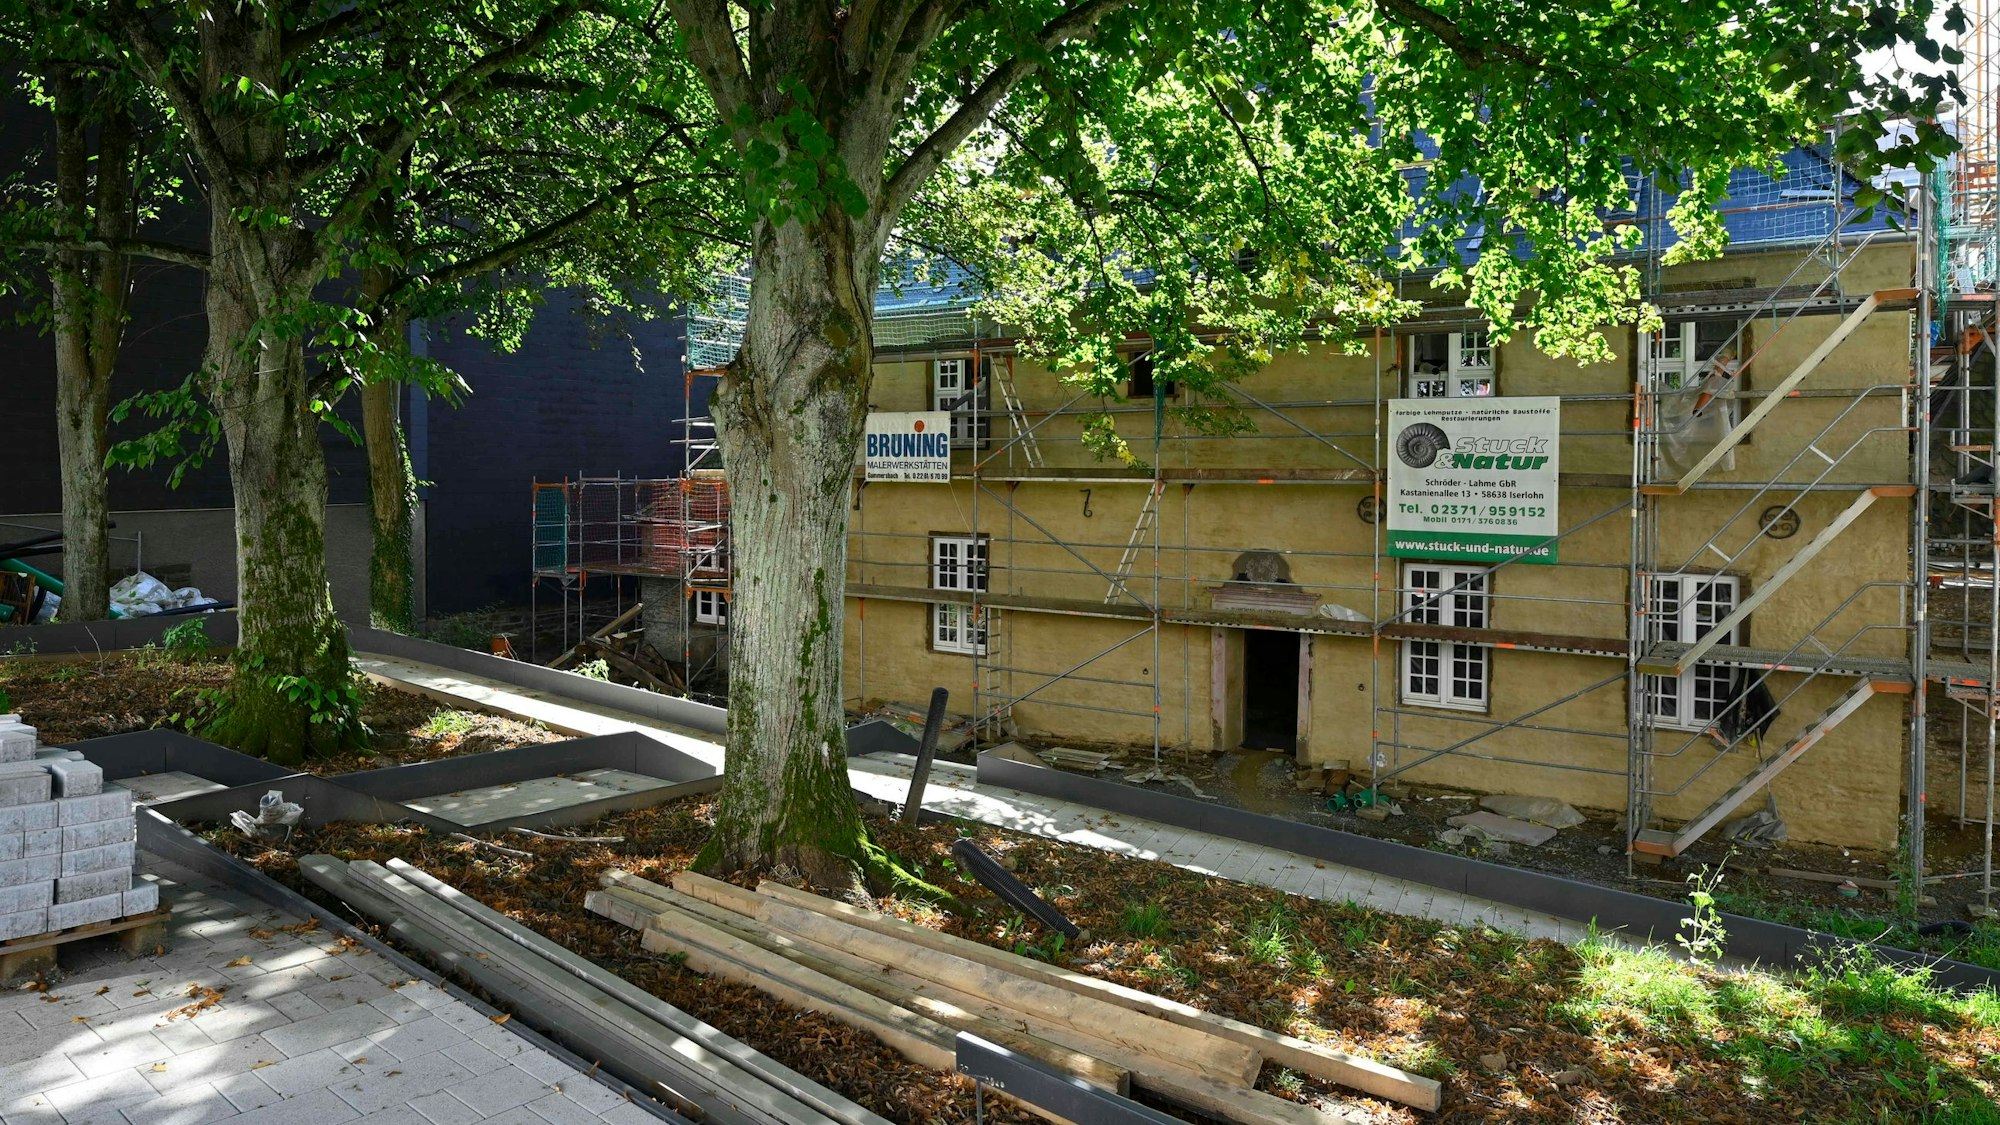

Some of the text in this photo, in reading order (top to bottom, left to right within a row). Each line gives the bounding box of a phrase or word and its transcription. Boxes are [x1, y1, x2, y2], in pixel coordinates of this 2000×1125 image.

[1455, 436, 1549, 454] Stuck
[867, 460, 948, 470] MALERWERKSTÄTTEN
[1425, 478, 1461, 487] Schröder
[1469, 479, 1496, 488] Lahme
[1499, 480, 1517, 488] GbR
[1400, 489, 1459, 498] Kastanienallee
[1462, 490, 1471, 498] 13
[1481, 491, 1507, 499] 58638
[1509, 491, 1544, 500] Iserlohn
[1399, 503, 1423, 514] Tel.
[1423, 516, 1447, 524] Mobil
[1395, 540, 1549, 556] www.stuck-und-natur.de
